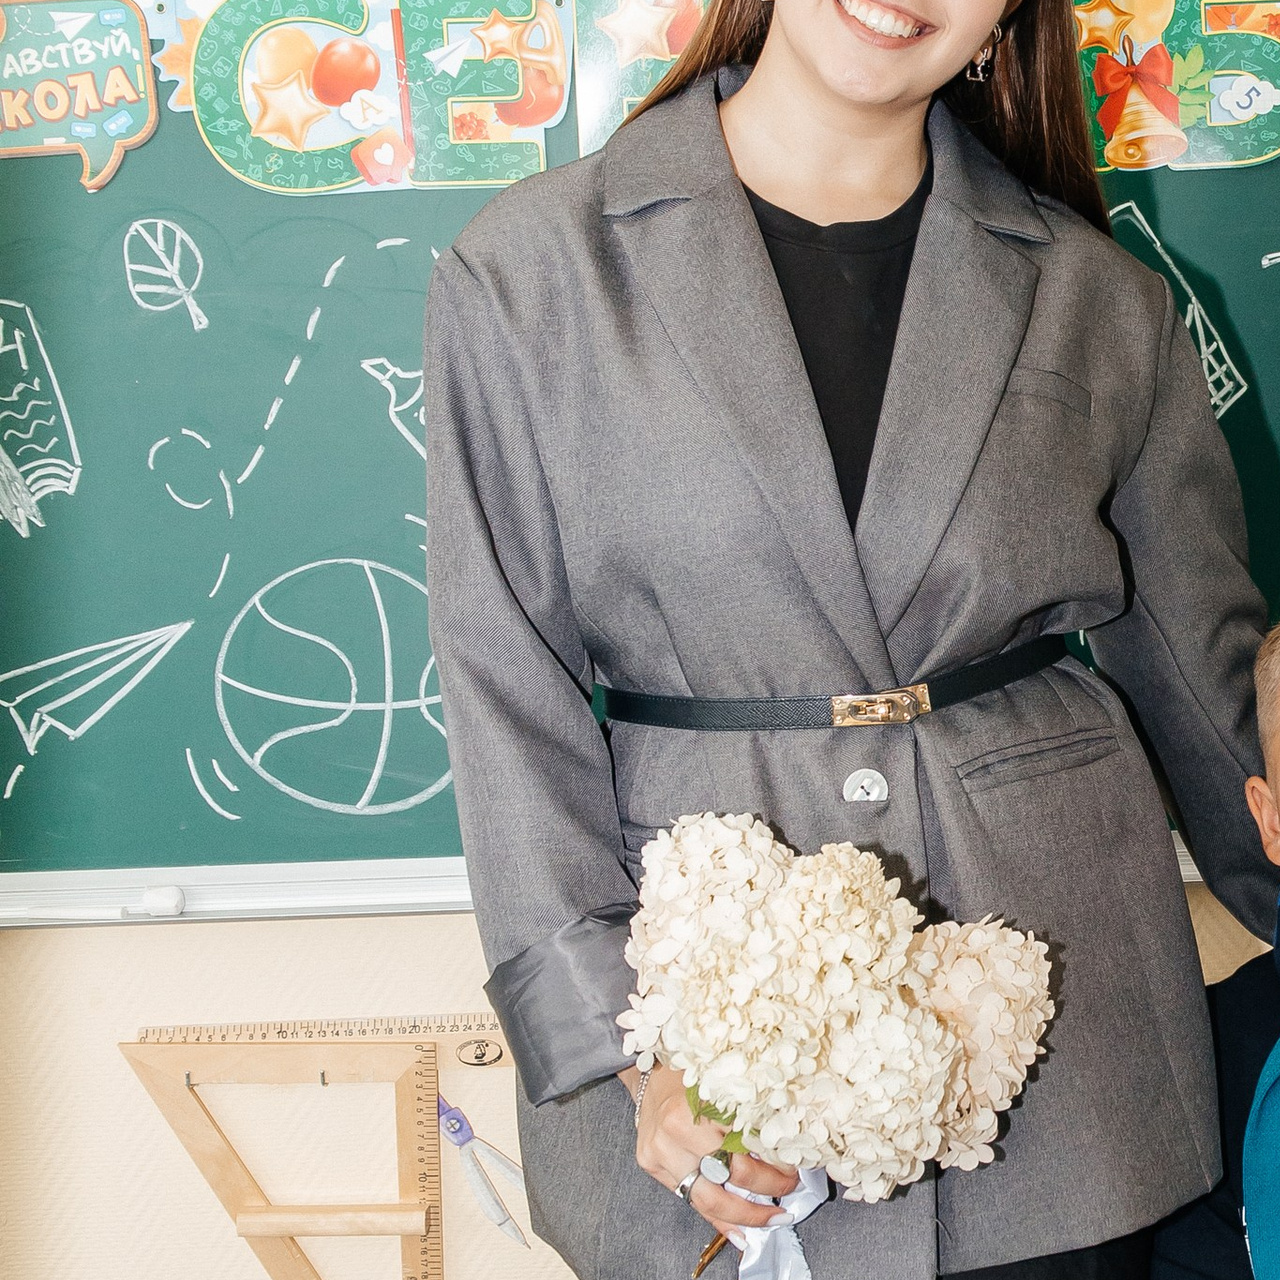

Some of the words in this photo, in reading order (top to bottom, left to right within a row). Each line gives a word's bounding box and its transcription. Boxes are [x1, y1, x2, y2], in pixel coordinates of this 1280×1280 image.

[0, 63, 146, 132] КОЛА!
[1235, 85, 1261, 110] 5
[276, 1030, 288, 1039] 10
[291, 1031, 299, 1039] 11
[304, 1030, 313, 1038] 12
[317, 1030, 327, 1038] 13
[331, 1029, 340, 1037] 14
[344, 1029, 353, 1037] 15
[358, 1028, 366, 1036] 16
[371, 1028, 379, 1036] 17
[384, 1027, 393, 1035] 18
[398, 1026, 406, 1034] 19
[408, 1024, 420, 1034] 20
[436, 1025, 446, 1033] 22
[449, 1024, 459, 1032] 23
[476, 1023, 486, 1031] 25
[418, 1172, 427, 1182] 10
[420, 1235, 427, 1243] 15
[421, 1247, 427, 1255] 16
[421, 1259, 428, 1267] 17
[421, 1271, 428, 1279] 18
